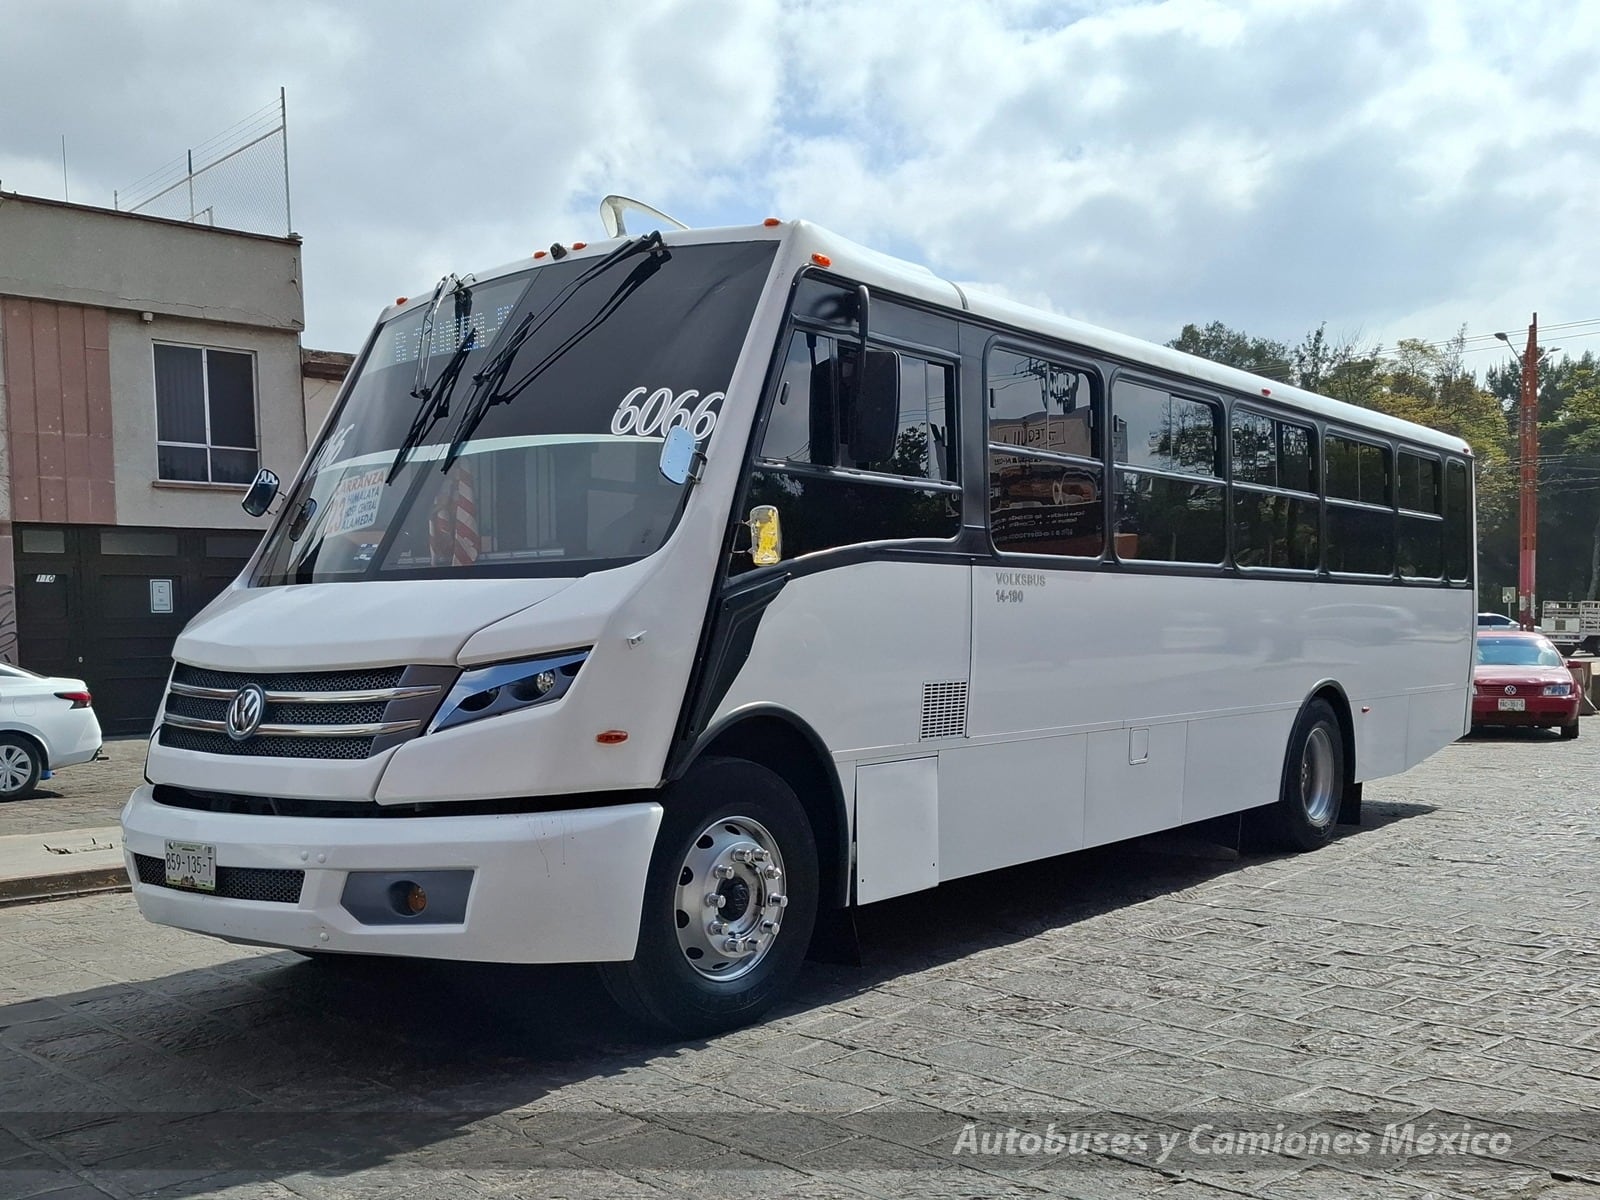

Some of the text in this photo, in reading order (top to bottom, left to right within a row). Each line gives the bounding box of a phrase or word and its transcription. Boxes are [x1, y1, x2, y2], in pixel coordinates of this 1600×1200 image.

[611, 386, 725, 441] 6066
[995, 572, 1046, 586] VOLKSBUS
[165, 852, 213, 876] 859-135-T
